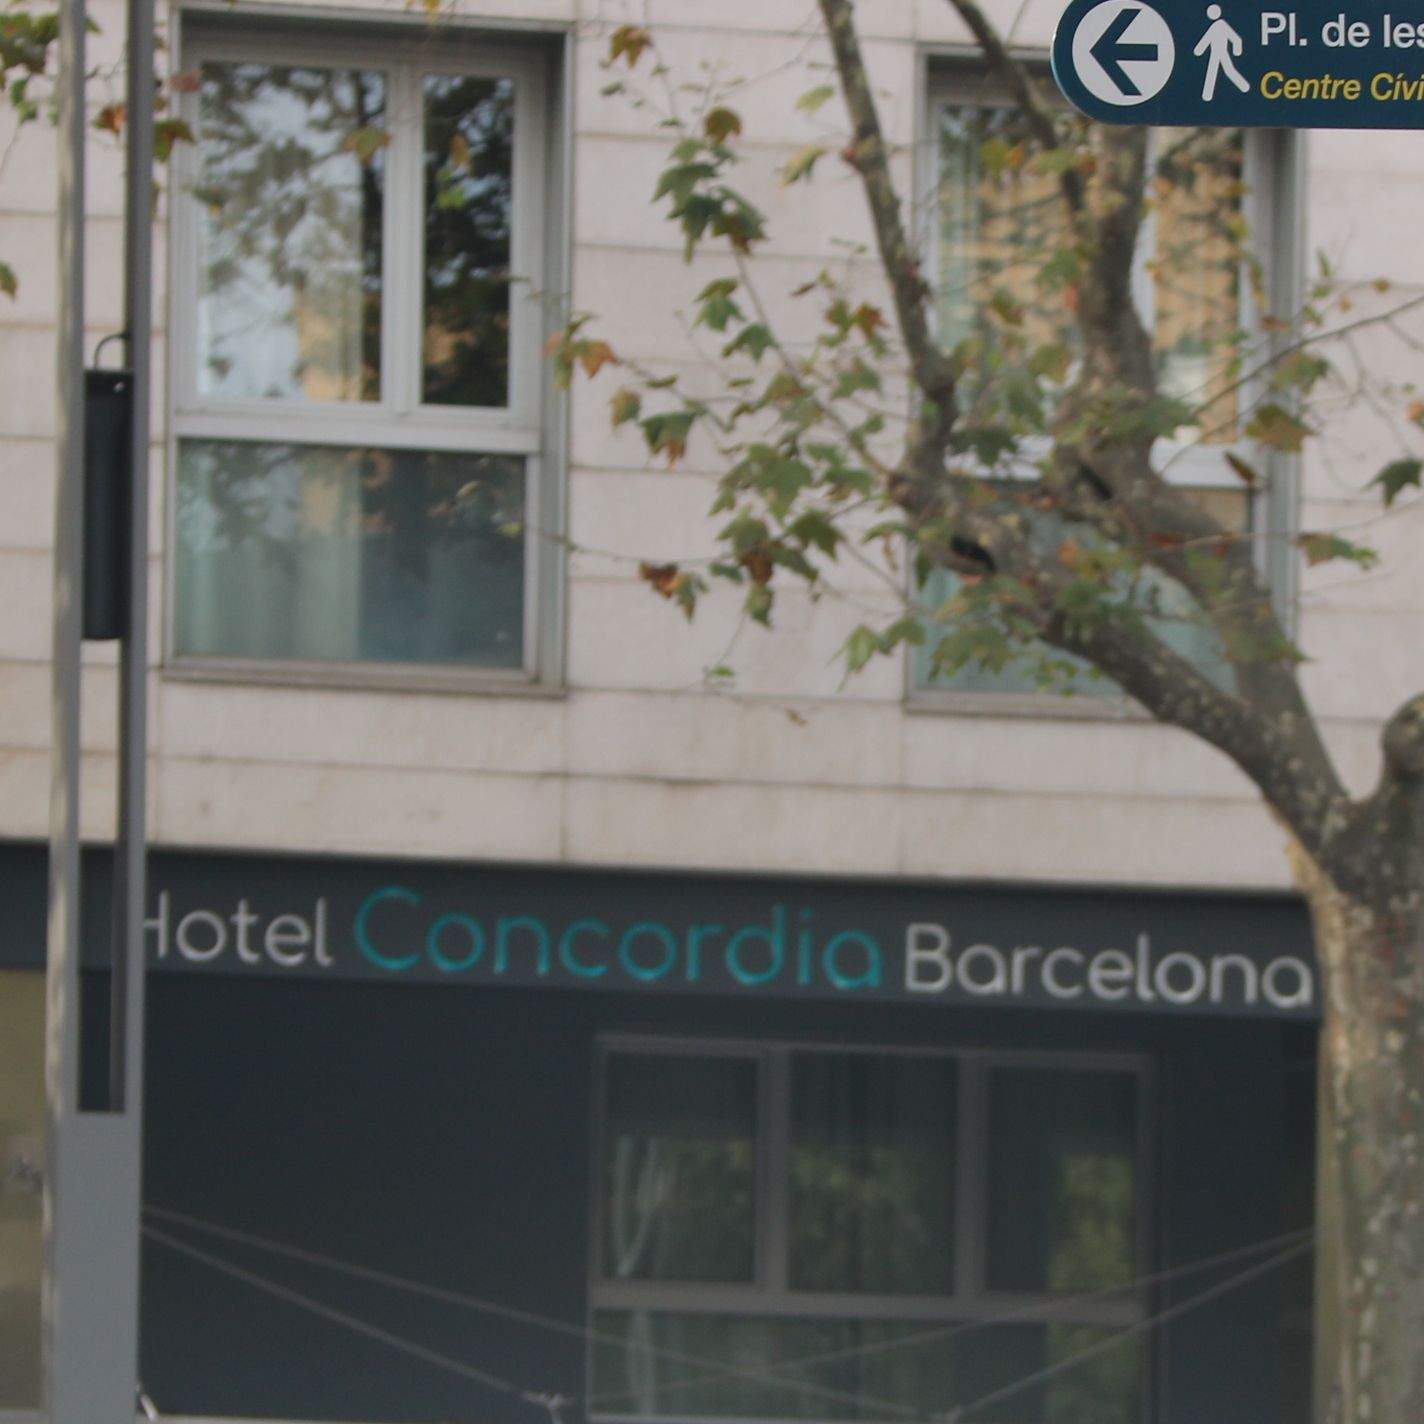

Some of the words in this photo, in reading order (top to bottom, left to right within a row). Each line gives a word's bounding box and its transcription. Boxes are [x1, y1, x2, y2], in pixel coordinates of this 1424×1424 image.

[1260, 12, 1307, 46] Pl.
[1322, 14, 1370, 48] de
[1259, 71, 1361, 100] Centre
[354, 885, 883, 989] Concordia
[904, 922, 1313, 1007] Barcelona
